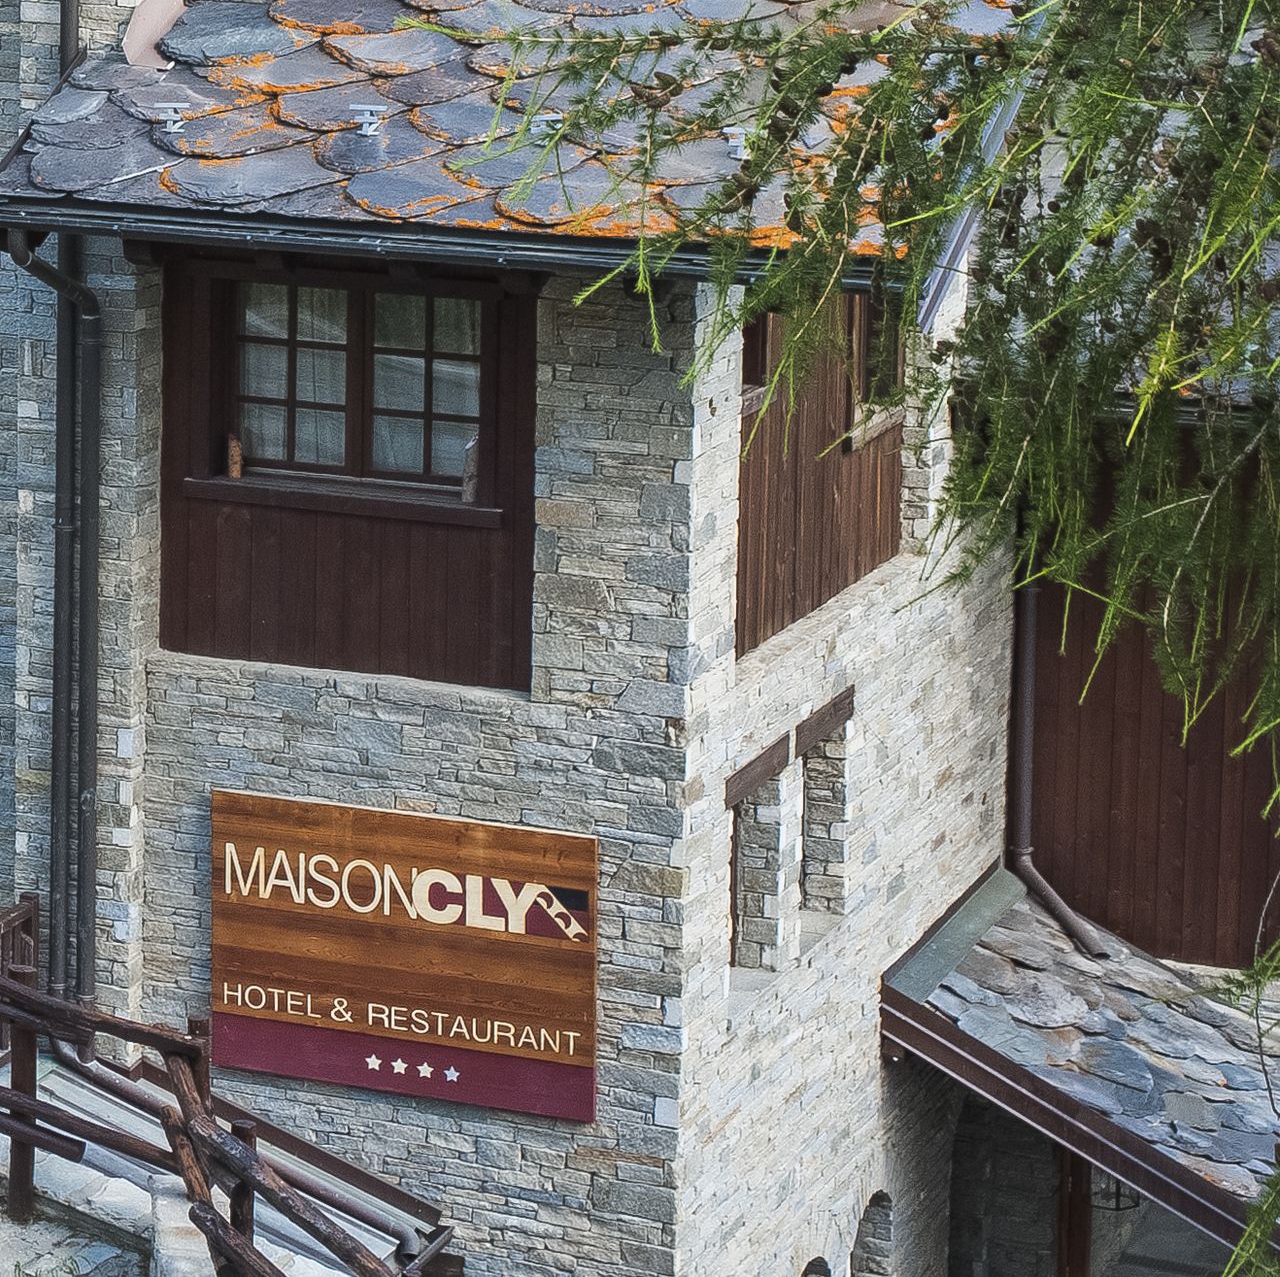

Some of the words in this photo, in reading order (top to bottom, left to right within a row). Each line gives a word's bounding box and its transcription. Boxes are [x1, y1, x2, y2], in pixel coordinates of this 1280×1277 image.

[223, 982, 321, 1019] HOTEL
[330, 997, 353, 1023] &
[368, 1002, 581, 1056] RESTAURANT
